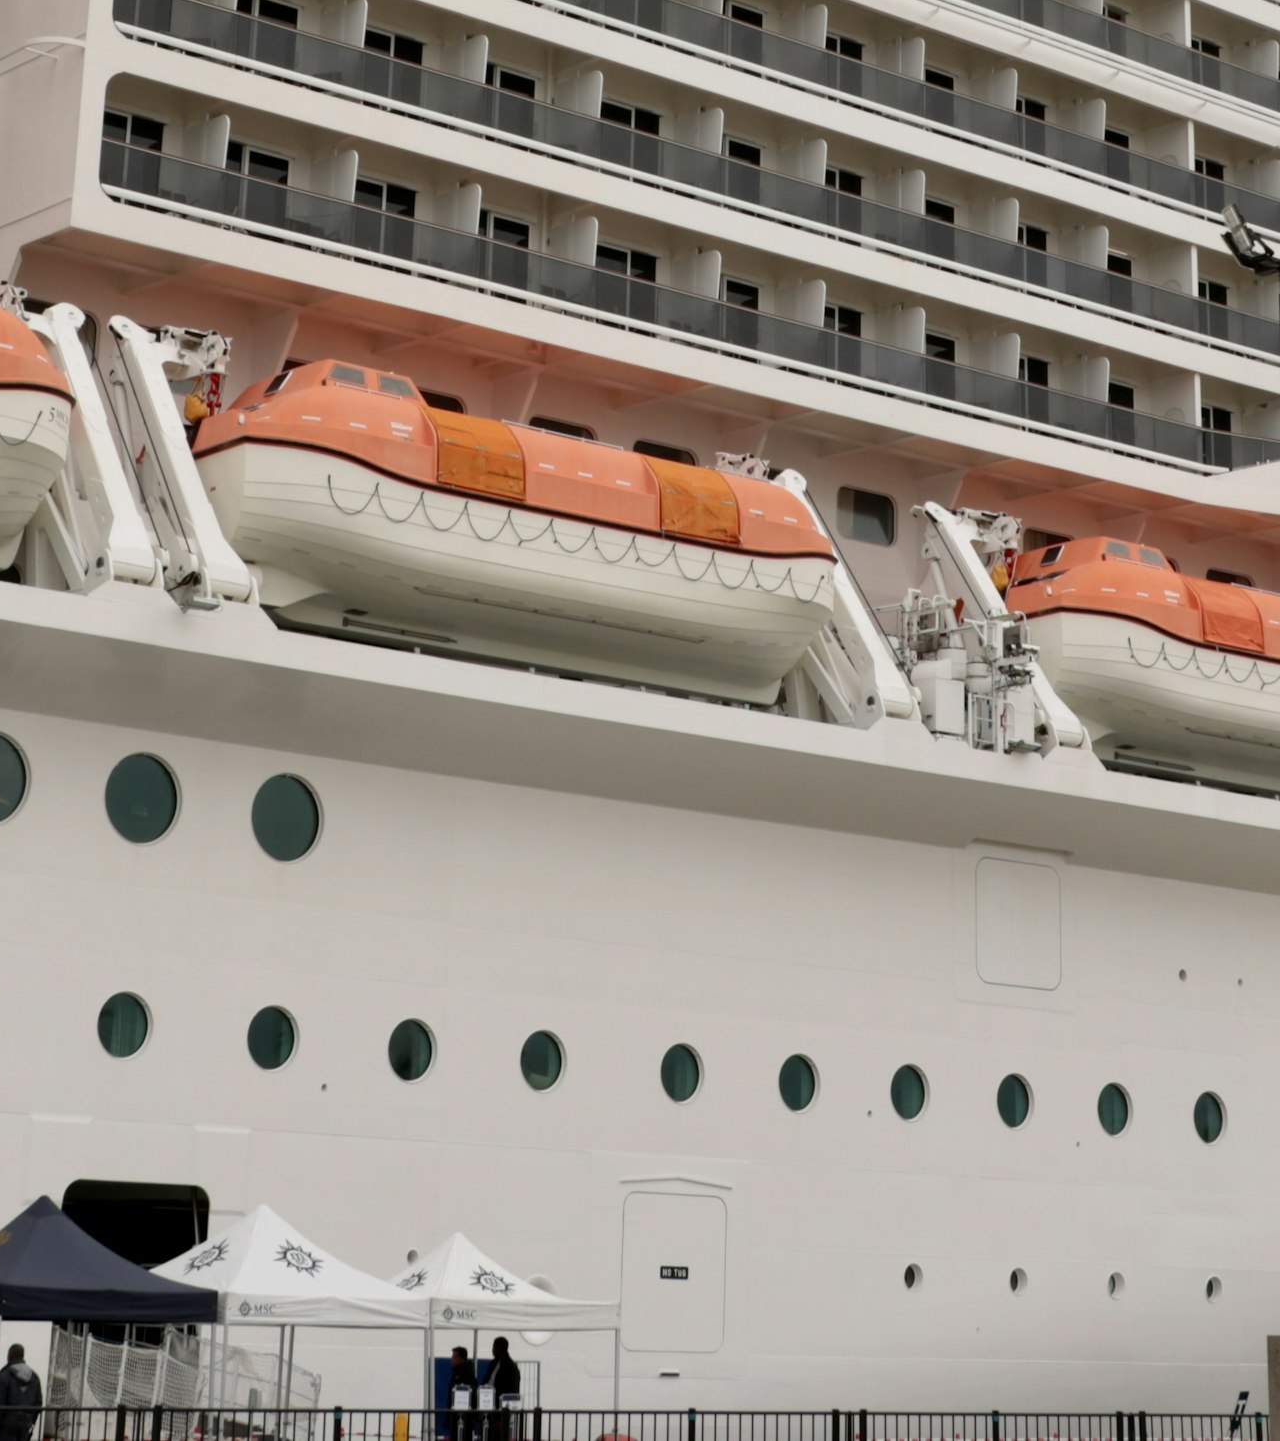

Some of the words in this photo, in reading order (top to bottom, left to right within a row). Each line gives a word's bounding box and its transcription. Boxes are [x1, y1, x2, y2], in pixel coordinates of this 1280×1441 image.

[662, 1268, 672, 1278] NO
[254, 1303, 277, 1315] MSC
[456, 1309, 477, 1321] MSC
